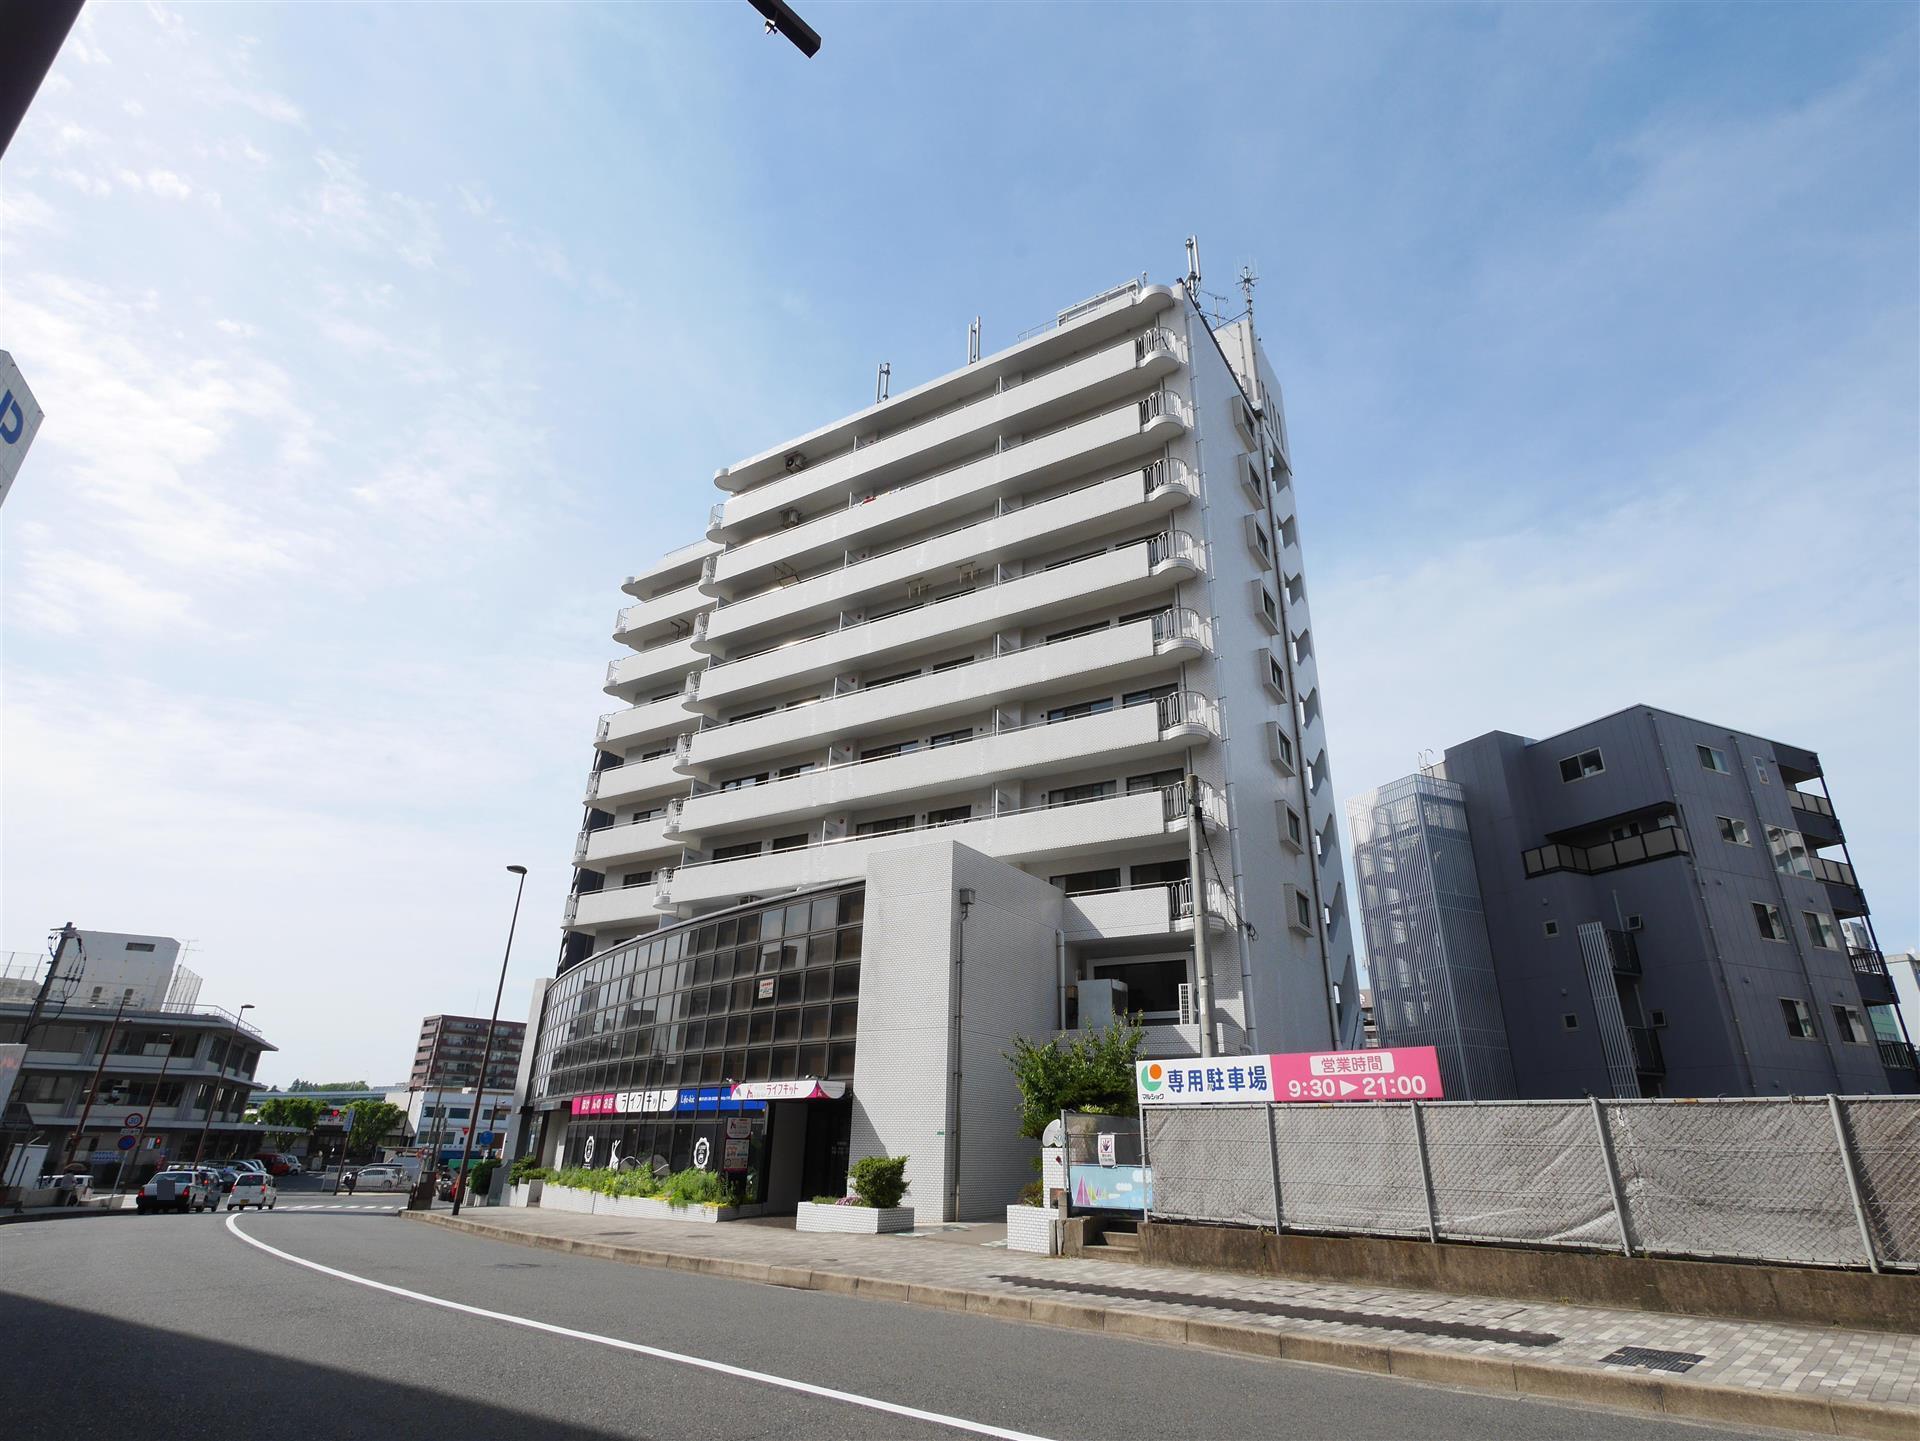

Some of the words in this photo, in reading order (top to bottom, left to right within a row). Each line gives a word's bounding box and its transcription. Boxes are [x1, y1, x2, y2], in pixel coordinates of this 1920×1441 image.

[1321, 1055, 1383, 1073] 営業時間
[1167, 1065, 1268, 1093] 専用駐車場
[1288, 1079, 1336, 1097] 9:30
[1362, 1075, 1427, 1096] 21:00
[766, 1083, 799, 1096] ライフキット
[621, 1092, 667, 1110] ライフキット
